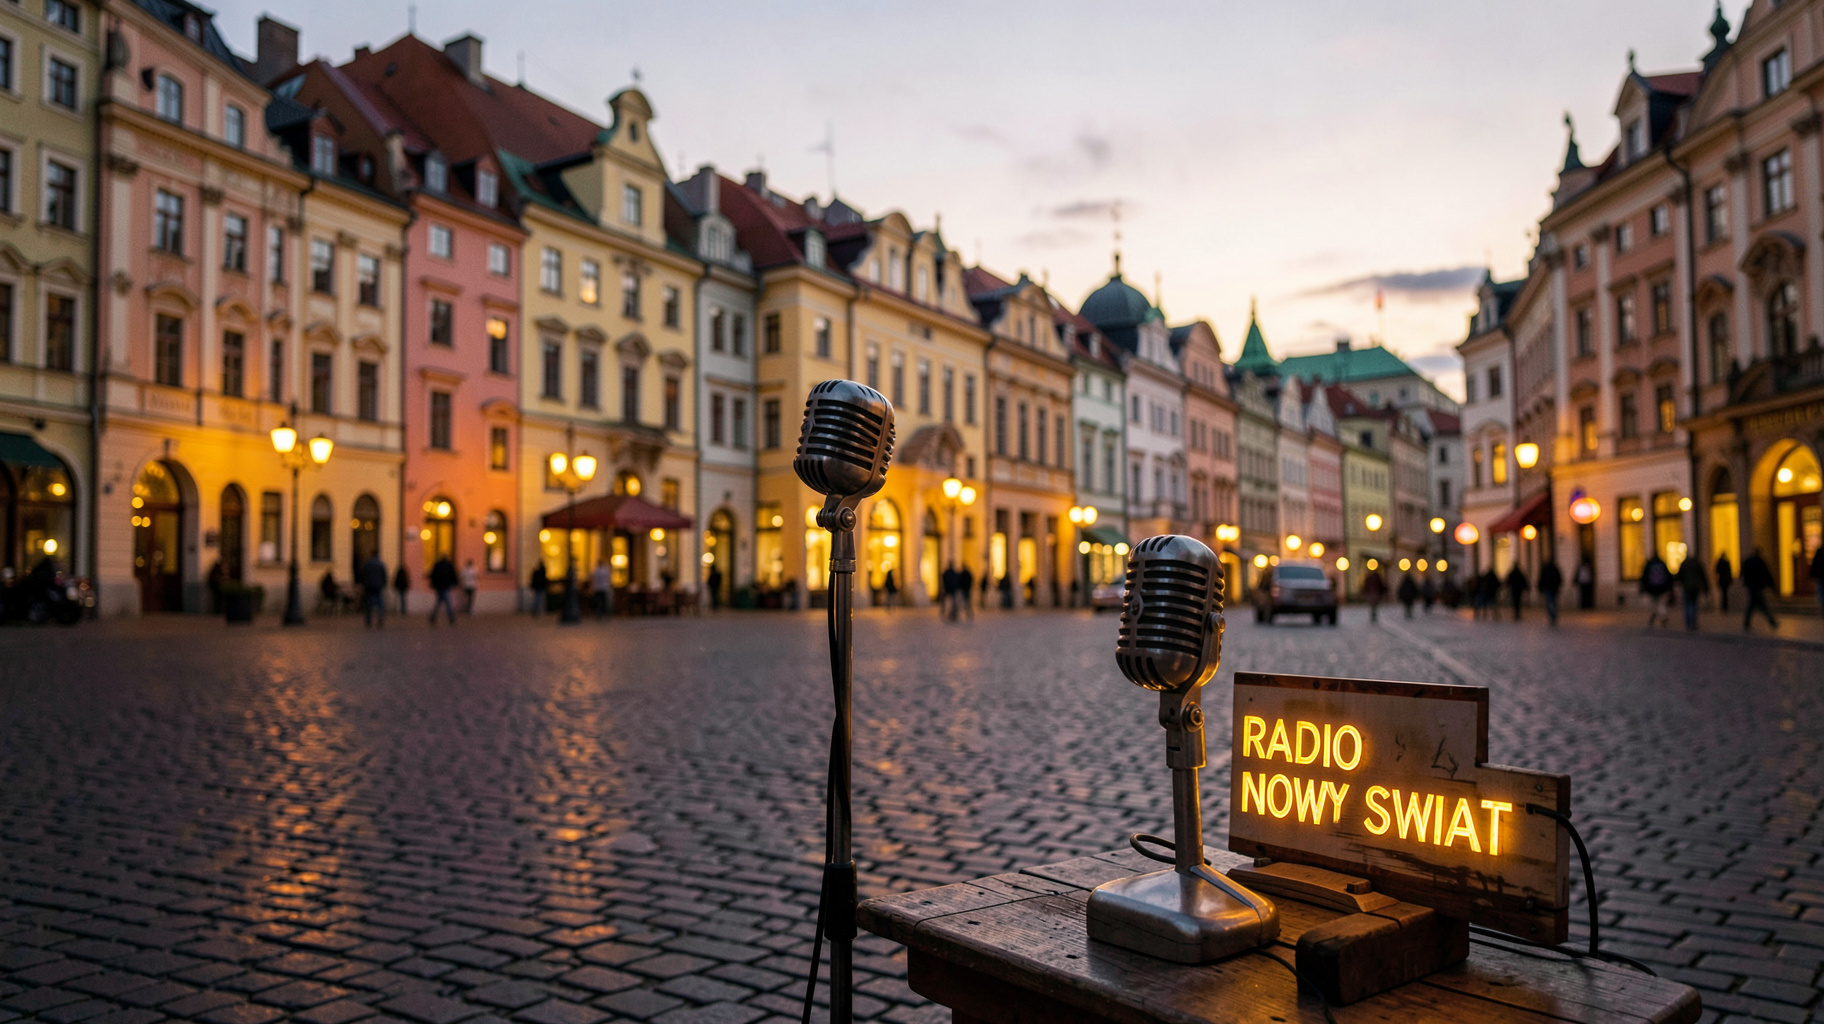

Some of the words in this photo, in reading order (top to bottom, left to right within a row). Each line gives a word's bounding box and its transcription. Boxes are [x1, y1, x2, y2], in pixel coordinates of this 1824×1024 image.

[1243, 715, 1362, 771] RADIO
[1242, 771, 1350, 825] NOWY
[1363, 785, 1512, 856] SWIAT
